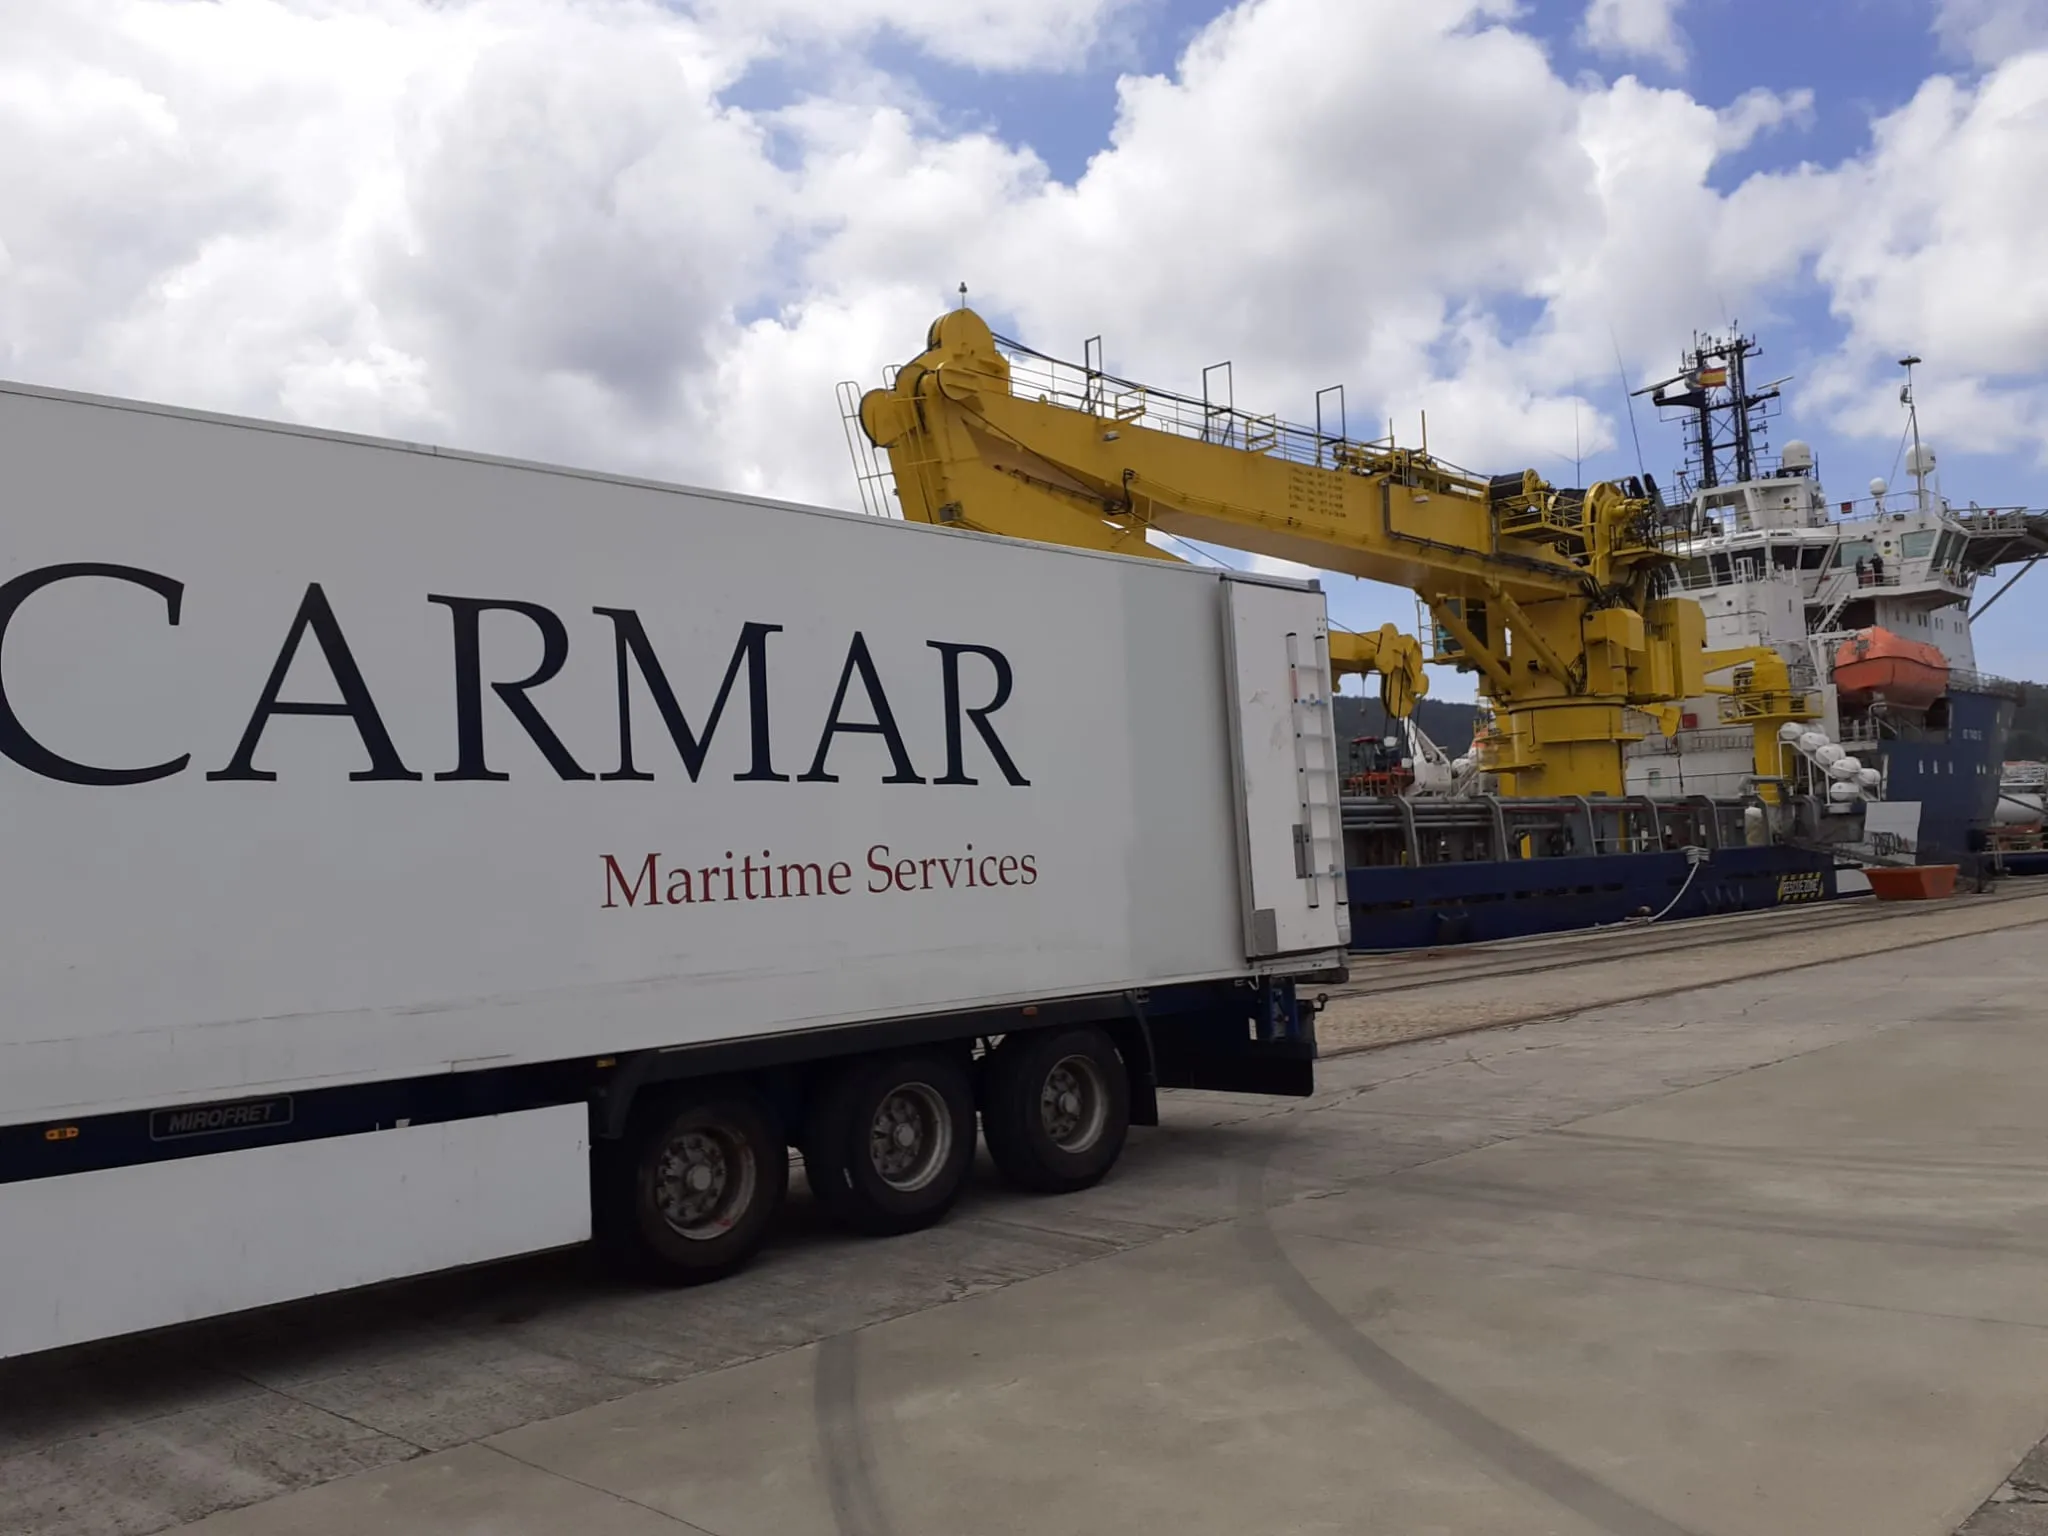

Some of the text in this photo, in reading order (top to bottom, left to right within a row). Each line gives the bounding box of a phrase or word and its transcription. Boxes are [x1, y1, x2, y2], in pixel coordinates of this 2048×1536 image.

[0, 562, 1031, 786] CARMAR
[600, 843, 1038, 908] Maritime Services
[169, 1103, 276, 1132] MIROFRET
